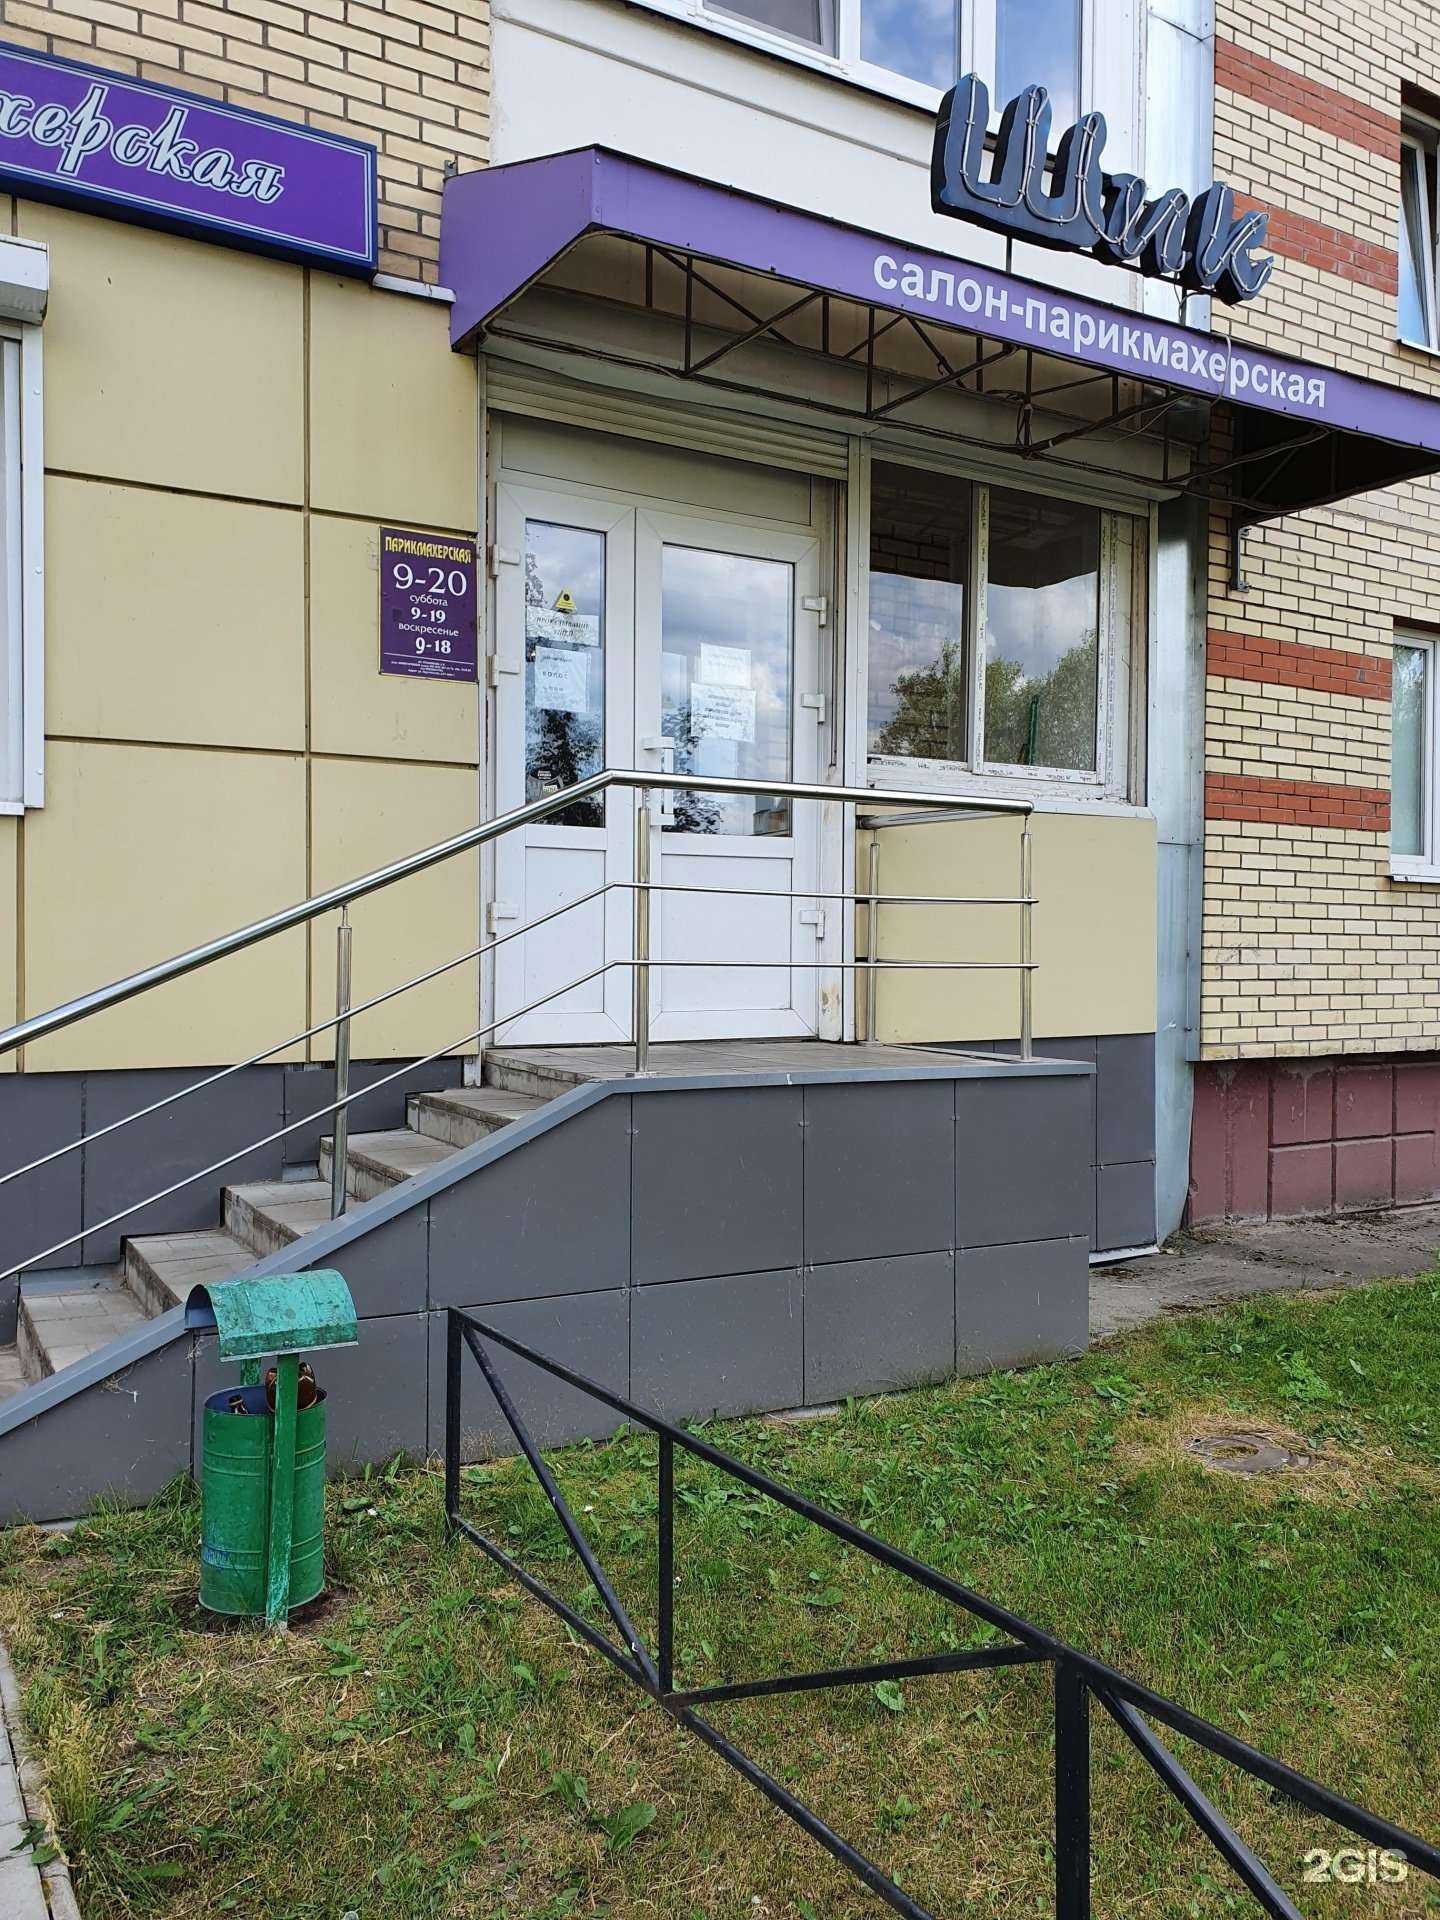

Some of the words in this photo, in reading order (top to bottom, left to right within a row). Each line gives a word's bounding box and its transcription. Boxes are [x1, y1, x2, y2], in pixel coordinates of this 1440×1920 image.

[873, 254, 1327, 408] салон-парикмахерская
[385, 536, 472, 564] ПАРИКМАХЕРСКАЯ
[393, 563, 467, 596] 9-20
[409, 594, 448, 607] суббота
[411, 607, 446, 623] 9-19
[398, 622, 460, 637] воскресенье
[415, 637, 451, 654] 9-18
